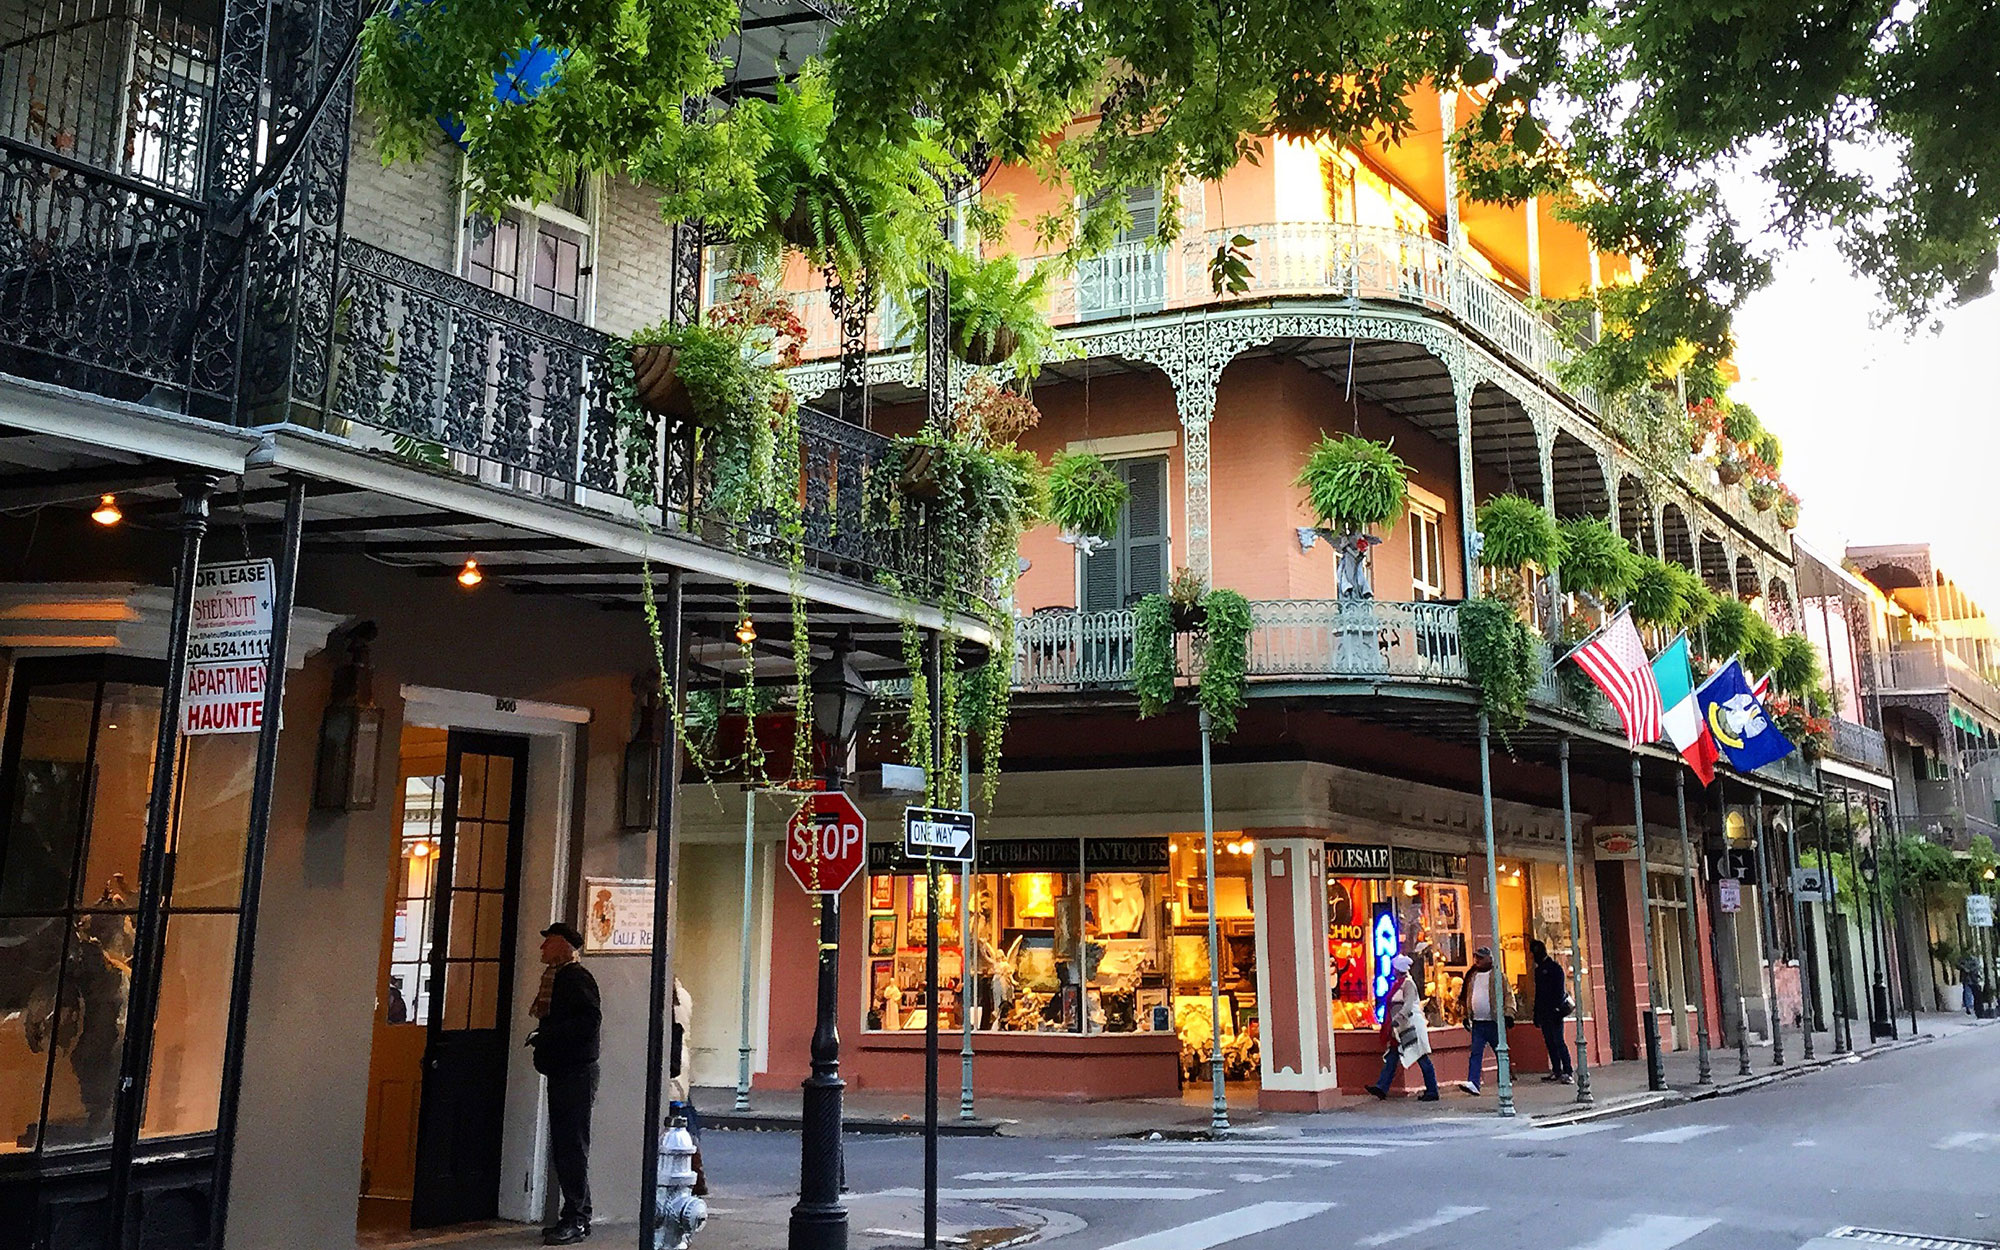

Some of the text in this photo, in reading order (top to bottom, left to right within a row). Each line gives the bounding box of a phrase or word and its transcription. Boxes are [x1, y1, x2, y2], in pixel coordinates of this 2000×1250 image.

[220, 566, 266, 585] LEASE
[194, 595, 257, 621] SHELNUTT
[187, 701, 263, 731] HAUNTE
[791, 823, 860, 861] STOP
[935, 825, 954, 844] WAY
[991, 843, 1079, 862] PUBLISHERS
[1086, 842, 1168, 864] ANTIQUES
[613, 929, 637, 945] CALLE
